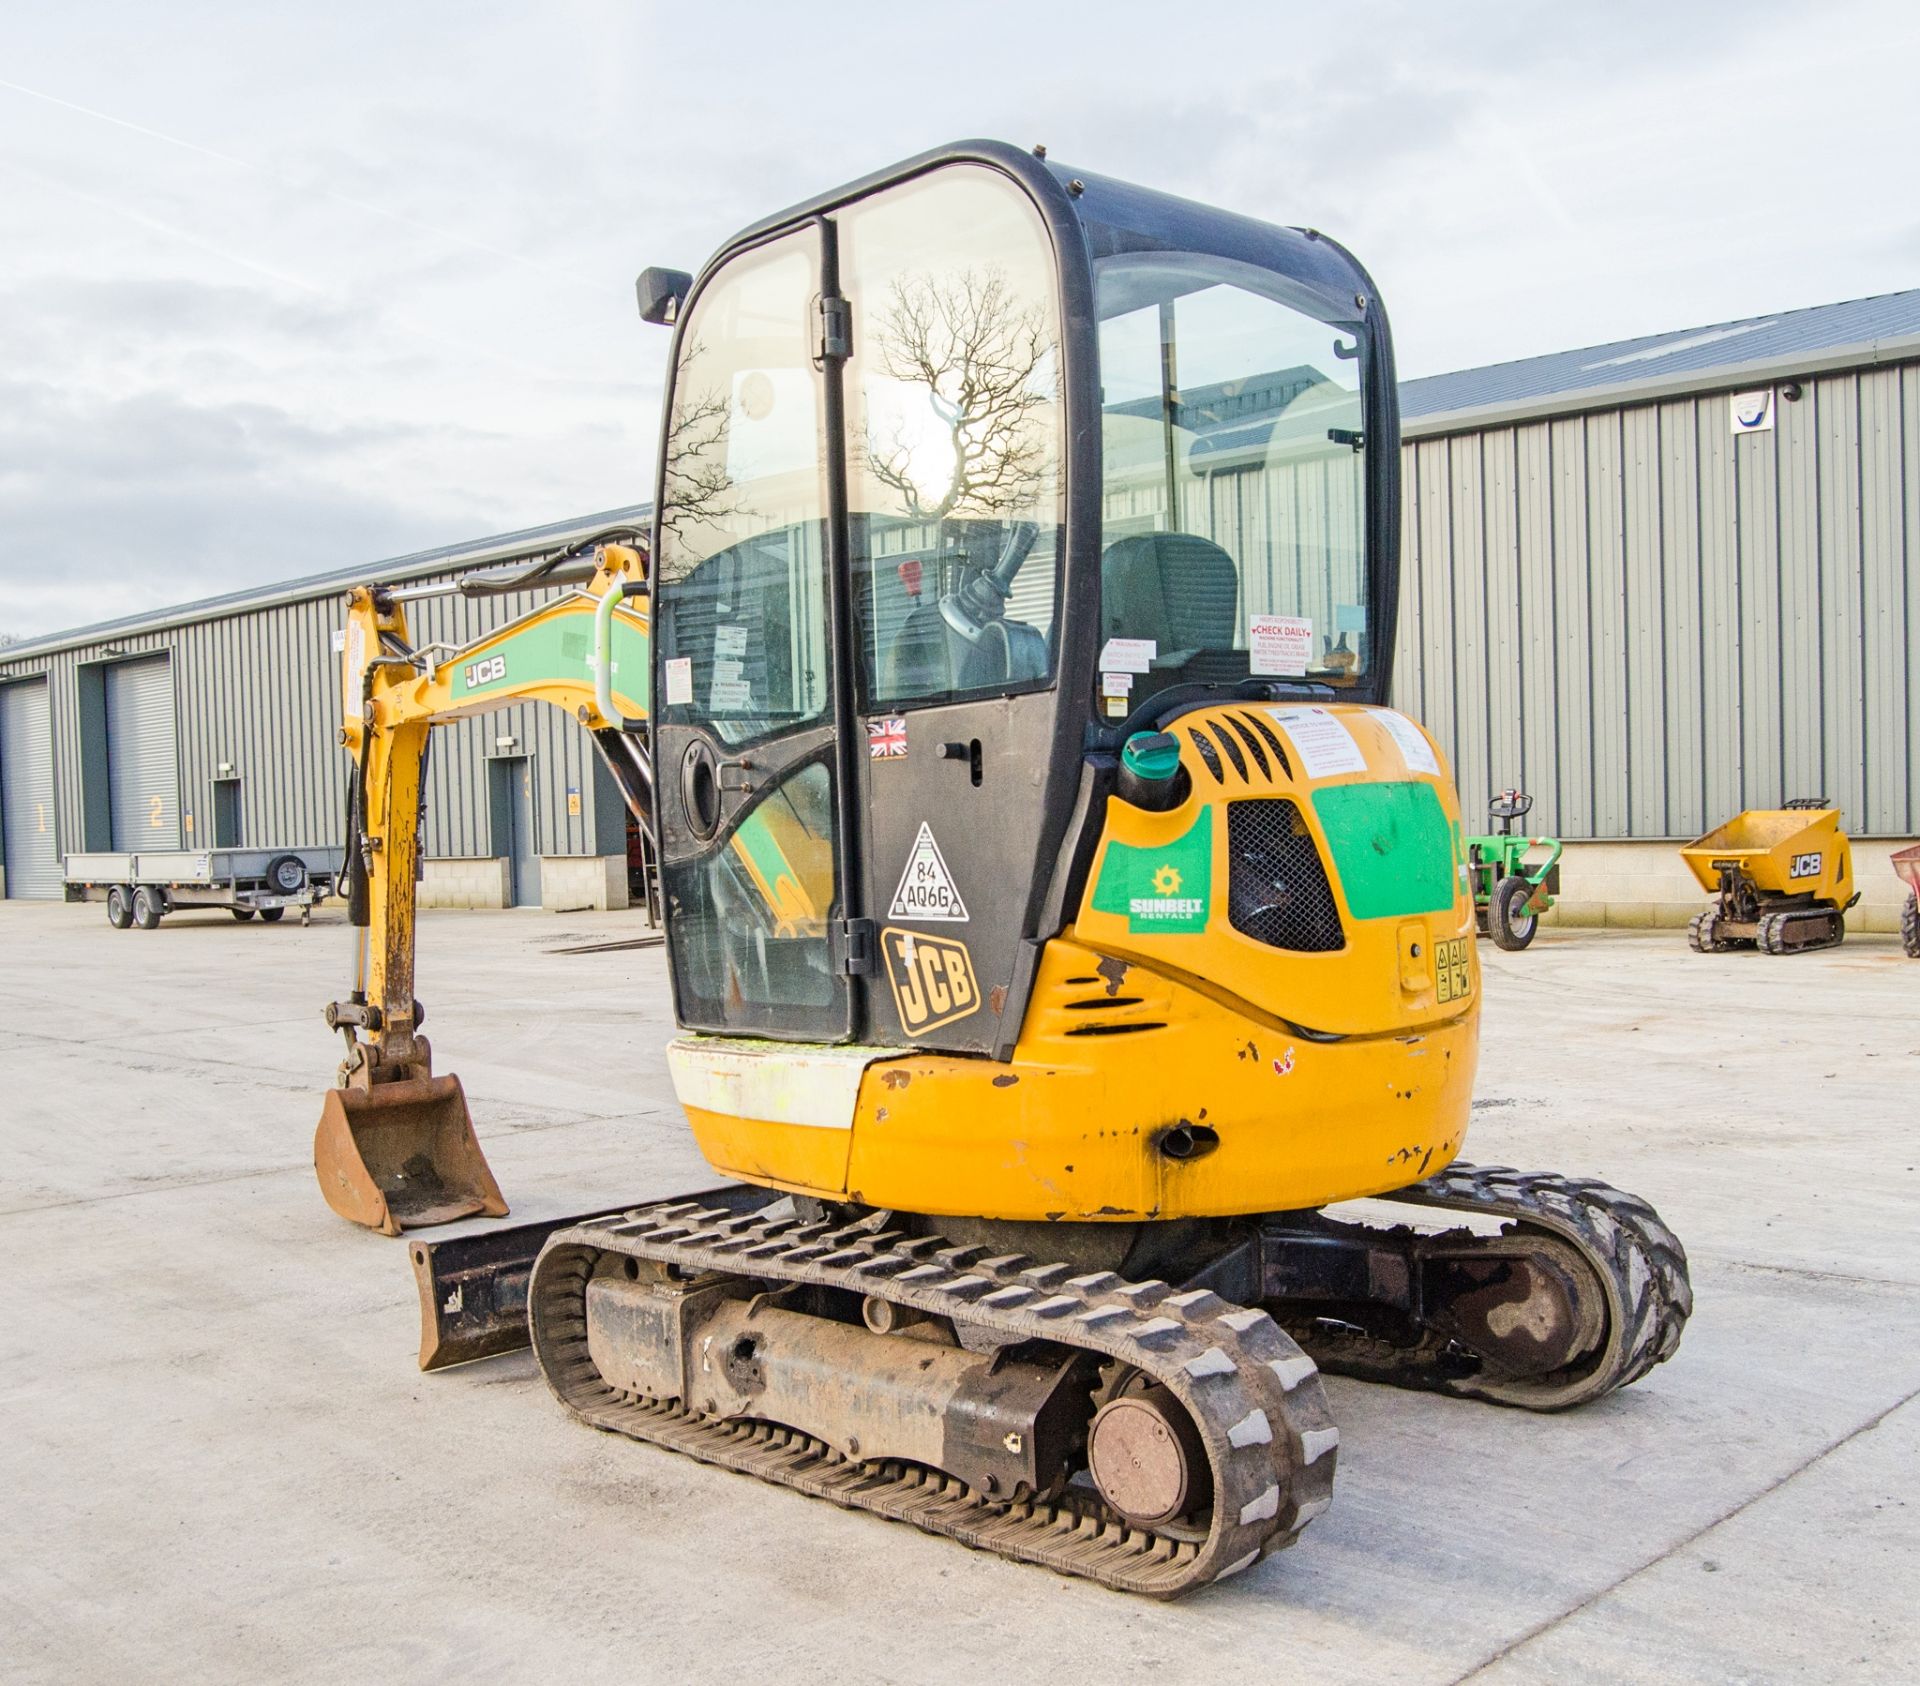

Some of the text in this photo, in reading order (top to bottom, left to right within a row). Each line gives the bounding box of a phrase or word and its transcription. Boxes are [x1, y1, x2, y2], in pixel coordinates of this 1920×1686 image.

[1256, 625, 1307, 637] CHECK DAILY
[465, 655, 506, 688] JCB
[37, 803, 46, 832] 1
[150, 795, 163, 827] 2
[917, 862, 936, 883] 84
[1790, 853, 1821, 877] JCB
[907, 886, 949, 907] AQ6G
[1130, 899, 1203, 913] SUNBELT
[895, 939, 972, 1025] JCB
